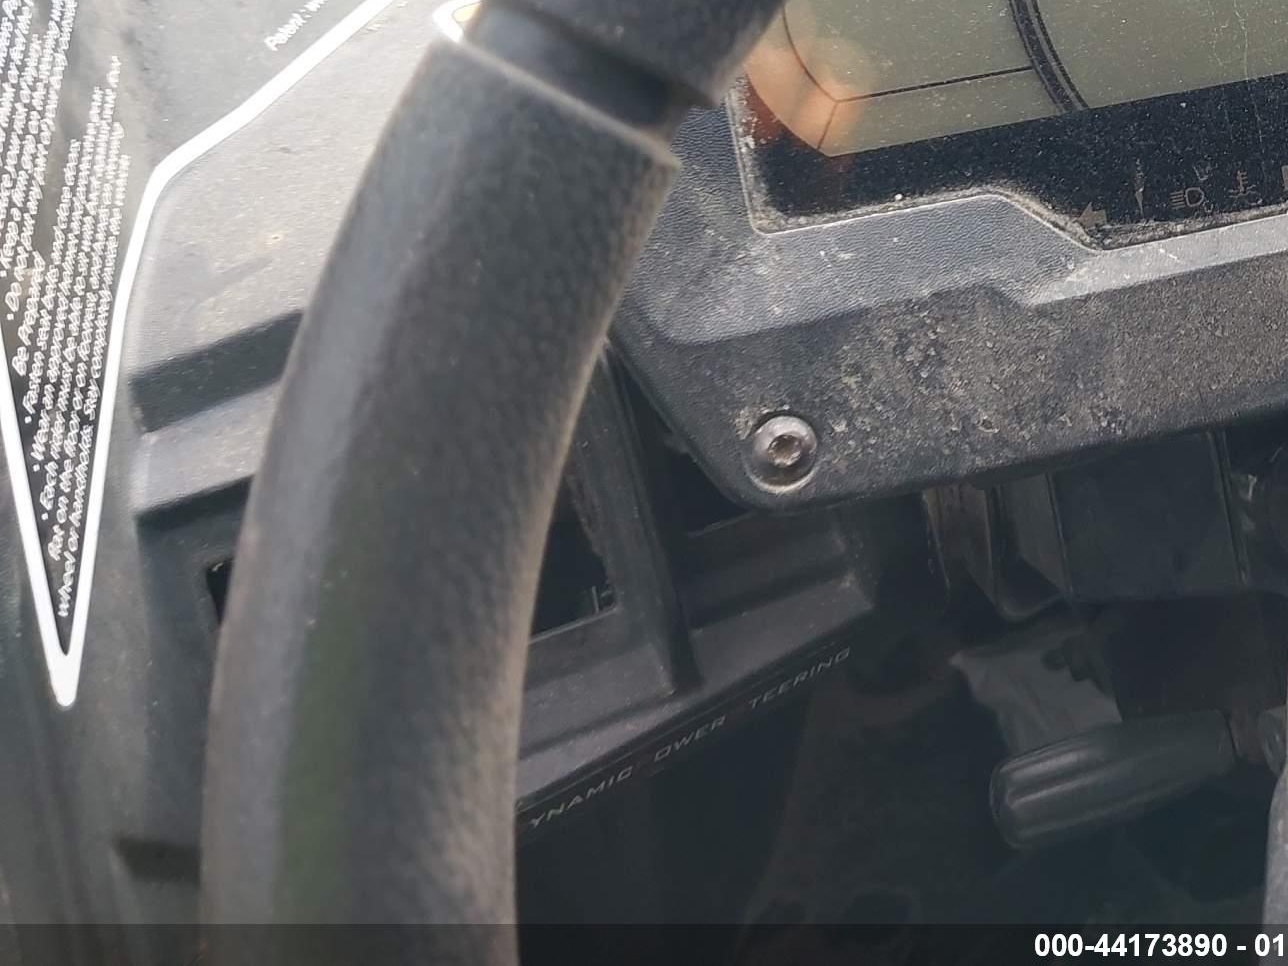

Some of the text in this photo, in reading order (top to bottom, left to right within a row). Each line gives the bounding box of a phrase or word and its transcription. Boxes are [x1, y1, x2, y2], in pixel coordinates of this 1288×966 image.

[265, 14, 304, 51] Patent
[56, 187, 72, 229] close
[51, 226, 64, 264] and
[41, 265, 59, 309] belts
[12, 252, 47, 376] Be Prepared
[37, 310, 51, 350] seat
[90, 285, 113, 379] completely
[41, 293, 71, 382] approved
[23, 352, 43, 413] Fasten
[76, 363, 87, 387] on
[43, 384, 54, 410] an
[73, 388, 83, 411] or
[84, 379, 98, 420] Stay
[32, 410, 49, 460] Wear
[64, 411, 79, 457] floor
[59, 459, 73, 492] the
[57, 496, 68, 523] on
[48, 525, 64, 560] flat
[68, 527, 78, 552] or
[58, 552, 75, 616] wheel
